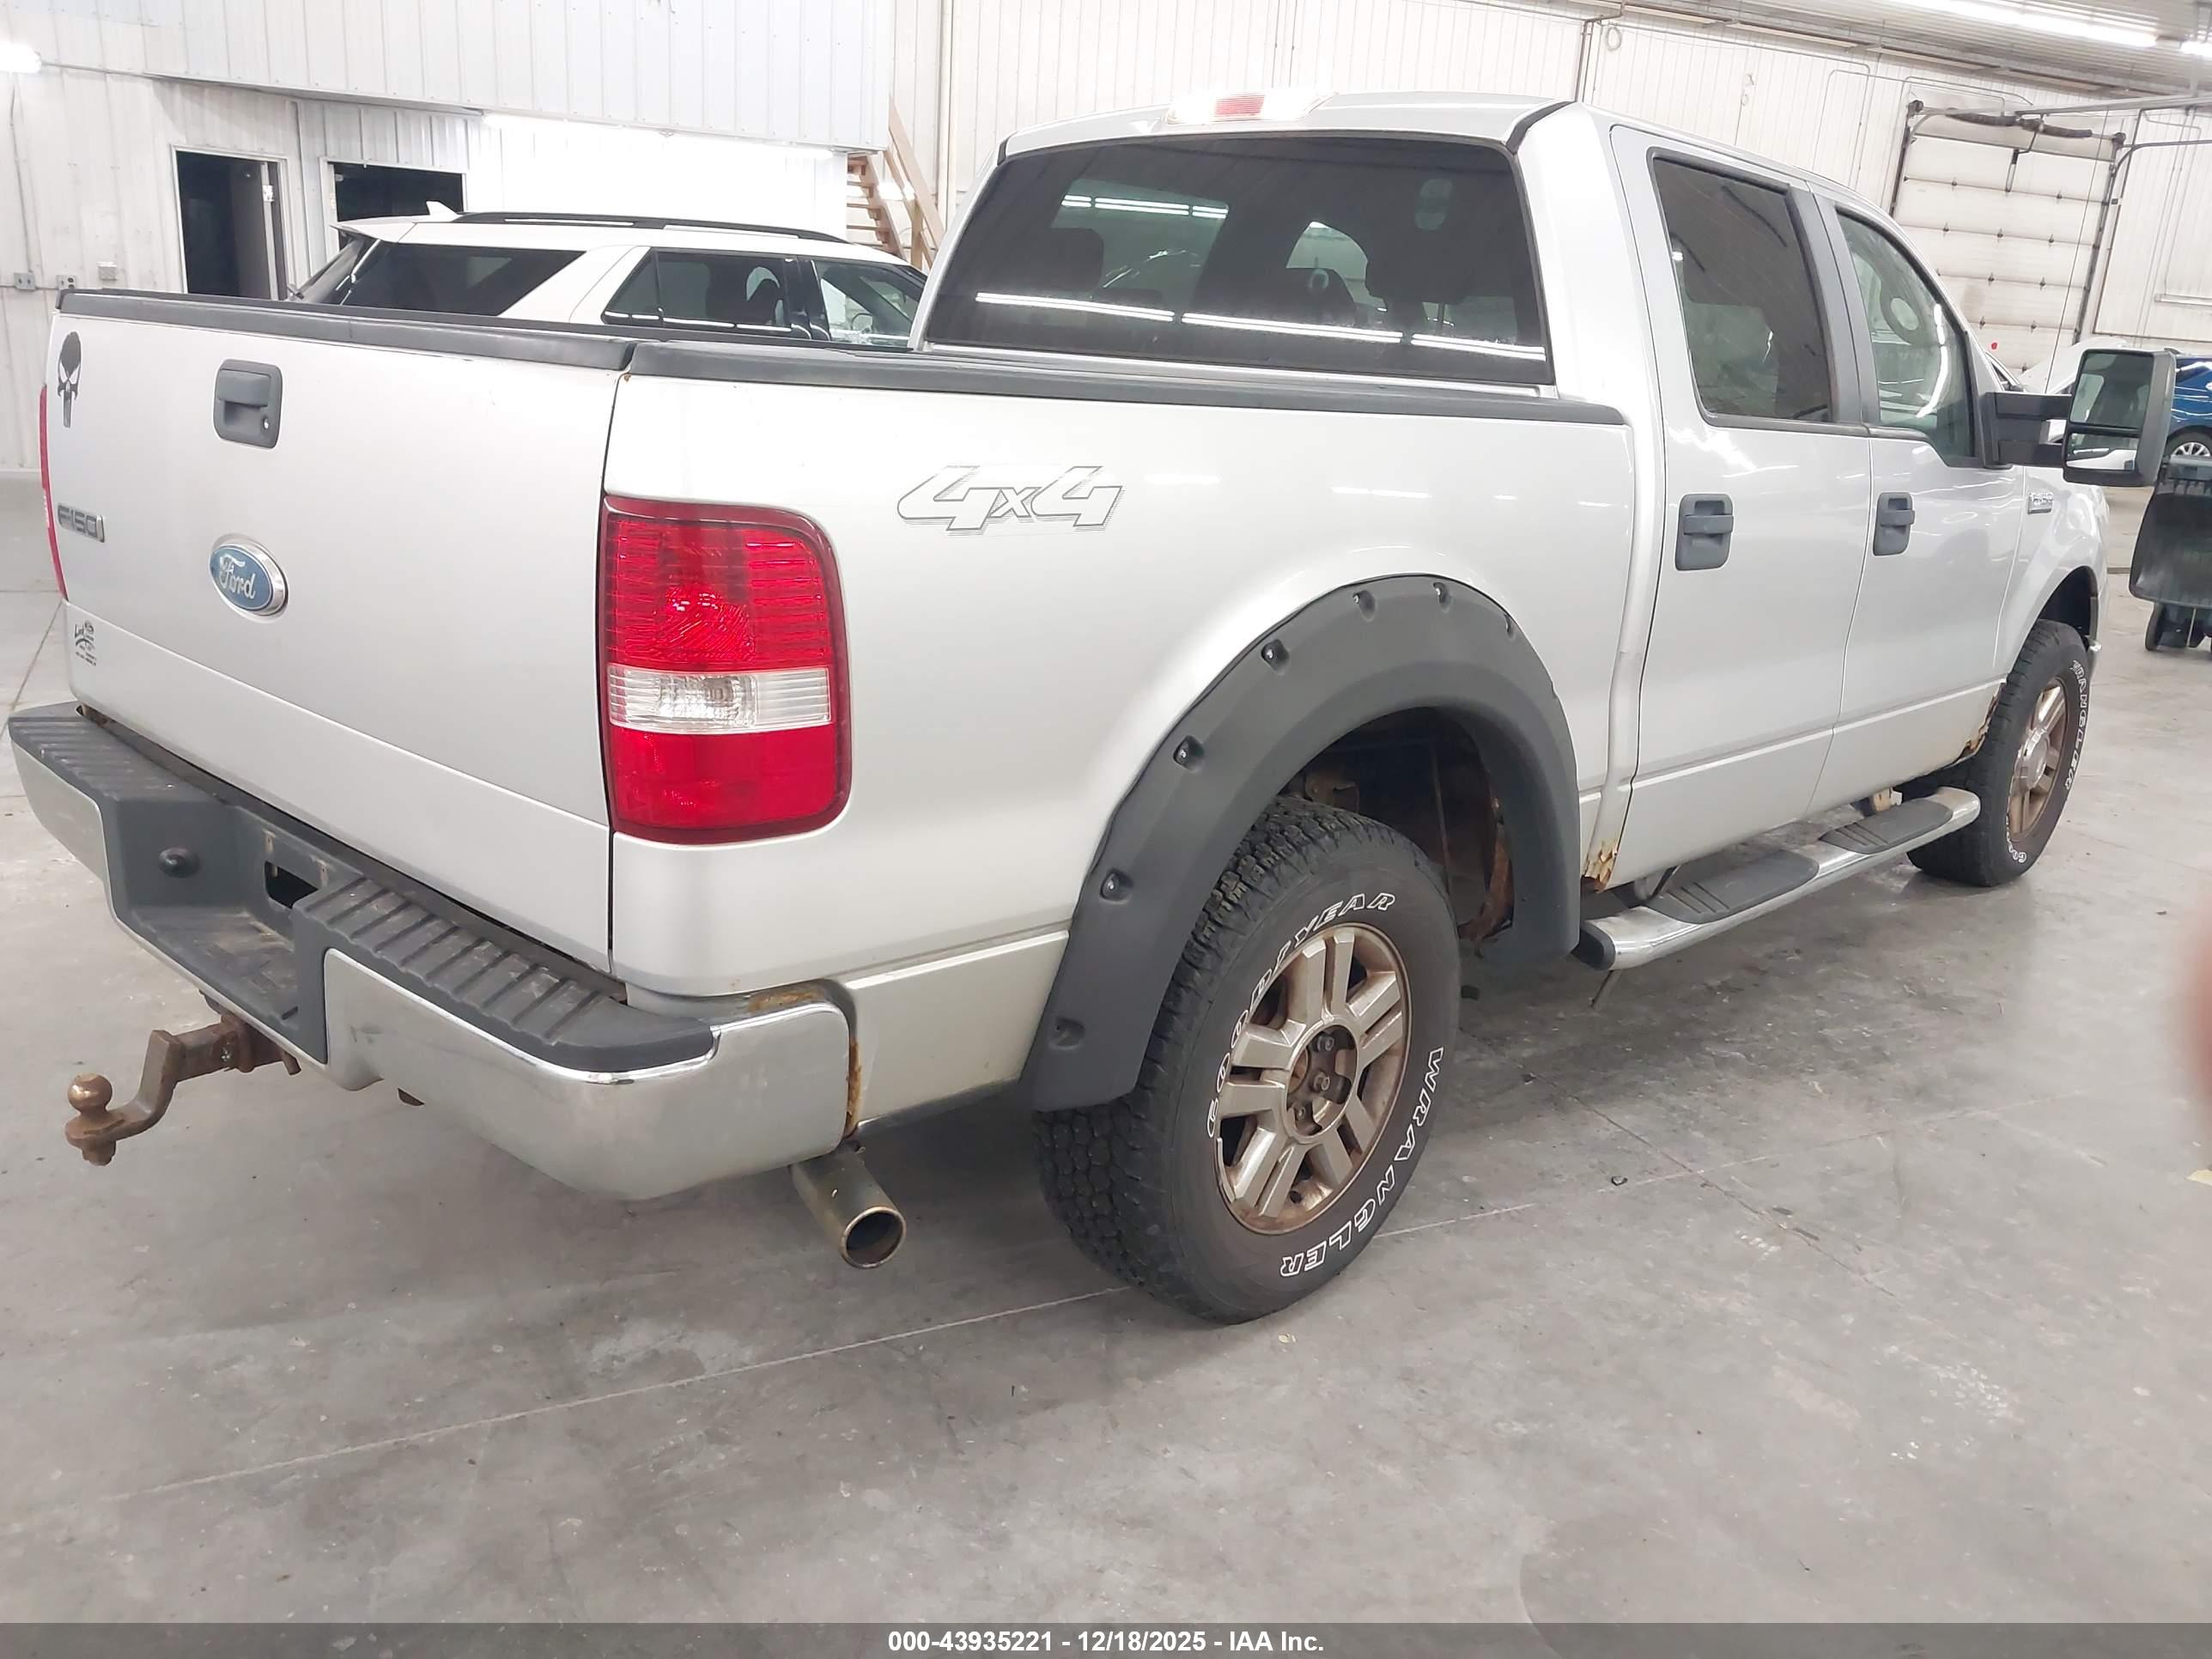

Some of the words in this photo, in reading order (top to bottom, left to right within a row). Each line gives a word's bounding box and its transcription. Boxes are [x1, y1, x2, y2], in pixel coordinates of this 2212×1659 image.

[897, 465, 1124, 533] 4x4
[219, 553, 257, 599] Ford
[1279, 1047, 1444, 1277] WRANGLER
